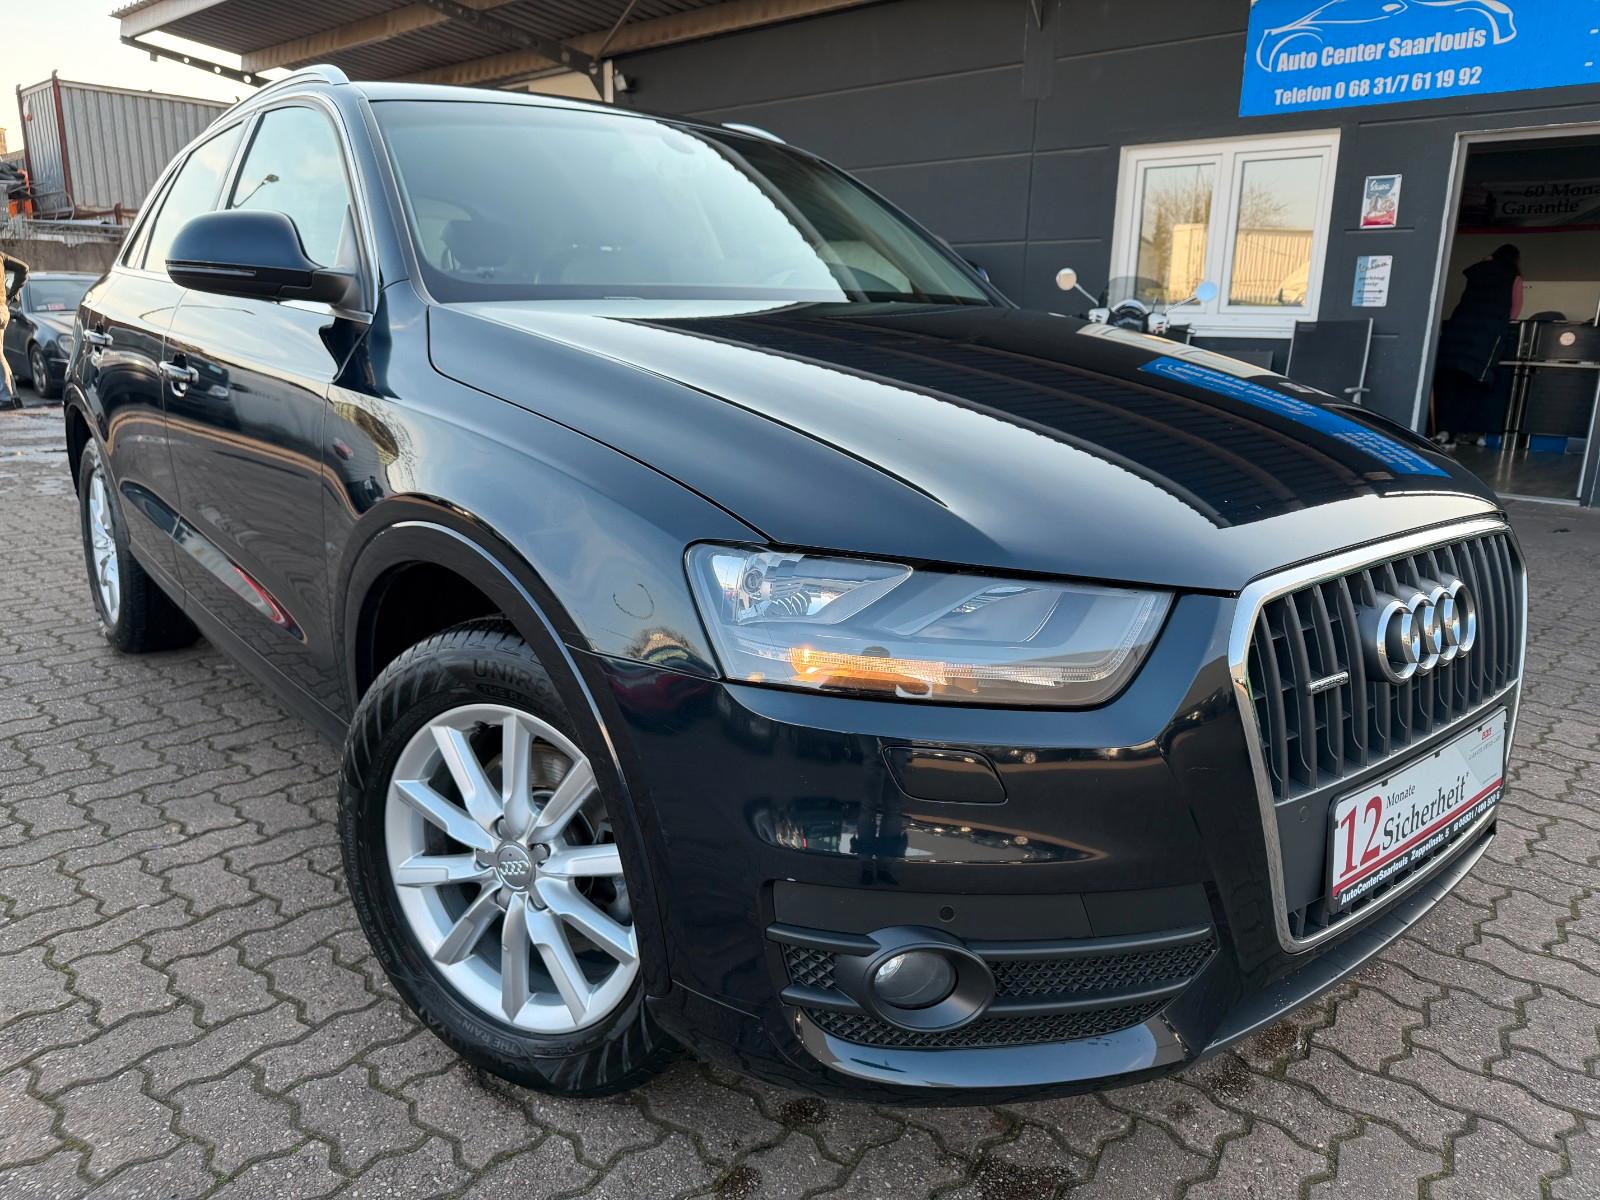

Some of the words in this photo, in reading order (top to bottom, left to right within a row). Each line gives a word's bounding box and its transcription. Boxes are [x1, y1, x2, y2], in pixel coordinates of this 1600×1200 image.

[1276, 50, 1318, 73] Auto
[1321, 43, 1386, 67] Center
[1388, 27, 1487, 58] Saarlouis
[1274, 85, 1333, 106] Telefon
[1335, 81, 1346, 99] 0
[1348, 79, 1371, 97] 68
[1373, 73, 1410, 95] 31/7
[1411, 72, 1432, 91] 61
[1435, 69, 1455, 88] 19
[1458, 66, 1482, 86] 92
[1502, 199, 1579, 215] Garantie
[1386, 785, 1416, 809] Monate
[1340, 796, 1383, 879] 12
[1341, 856, 1408, 905] AutoCenterSaarlouis
